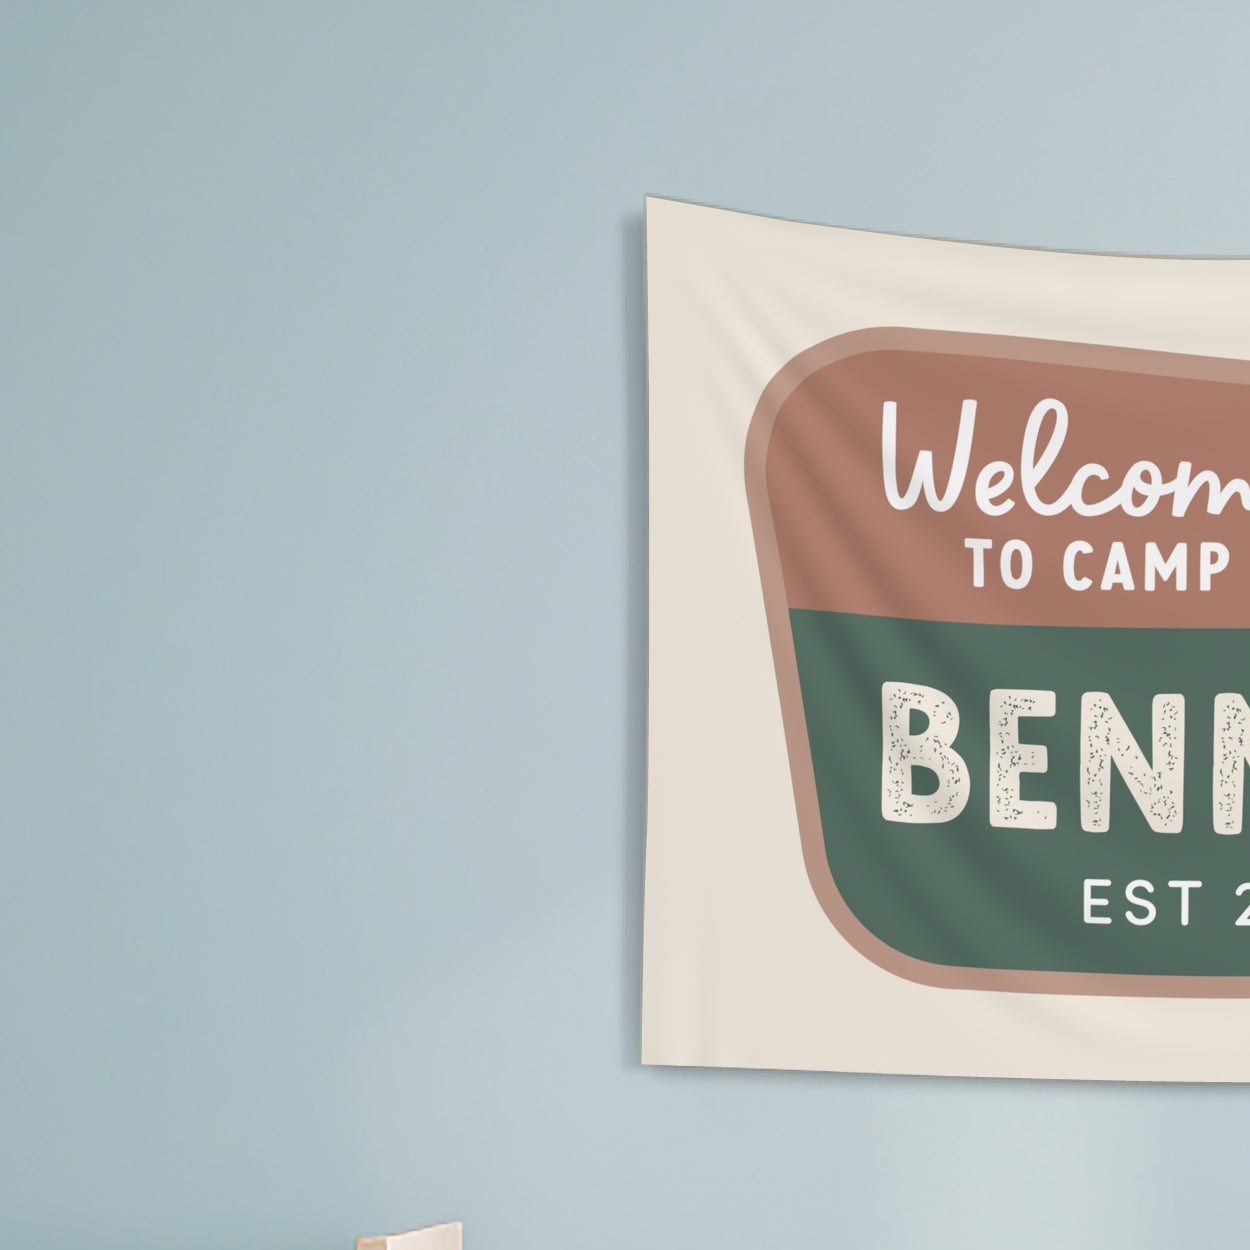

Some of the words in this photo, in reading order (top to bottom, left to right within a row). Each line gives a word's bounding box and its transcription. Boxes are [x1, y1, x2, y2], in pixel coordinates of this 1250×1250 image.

[963, 536, 1034, 591] TO
[1062, 538, 1231, 592] CAMP
[1082, 878, 1203, 927] EST
